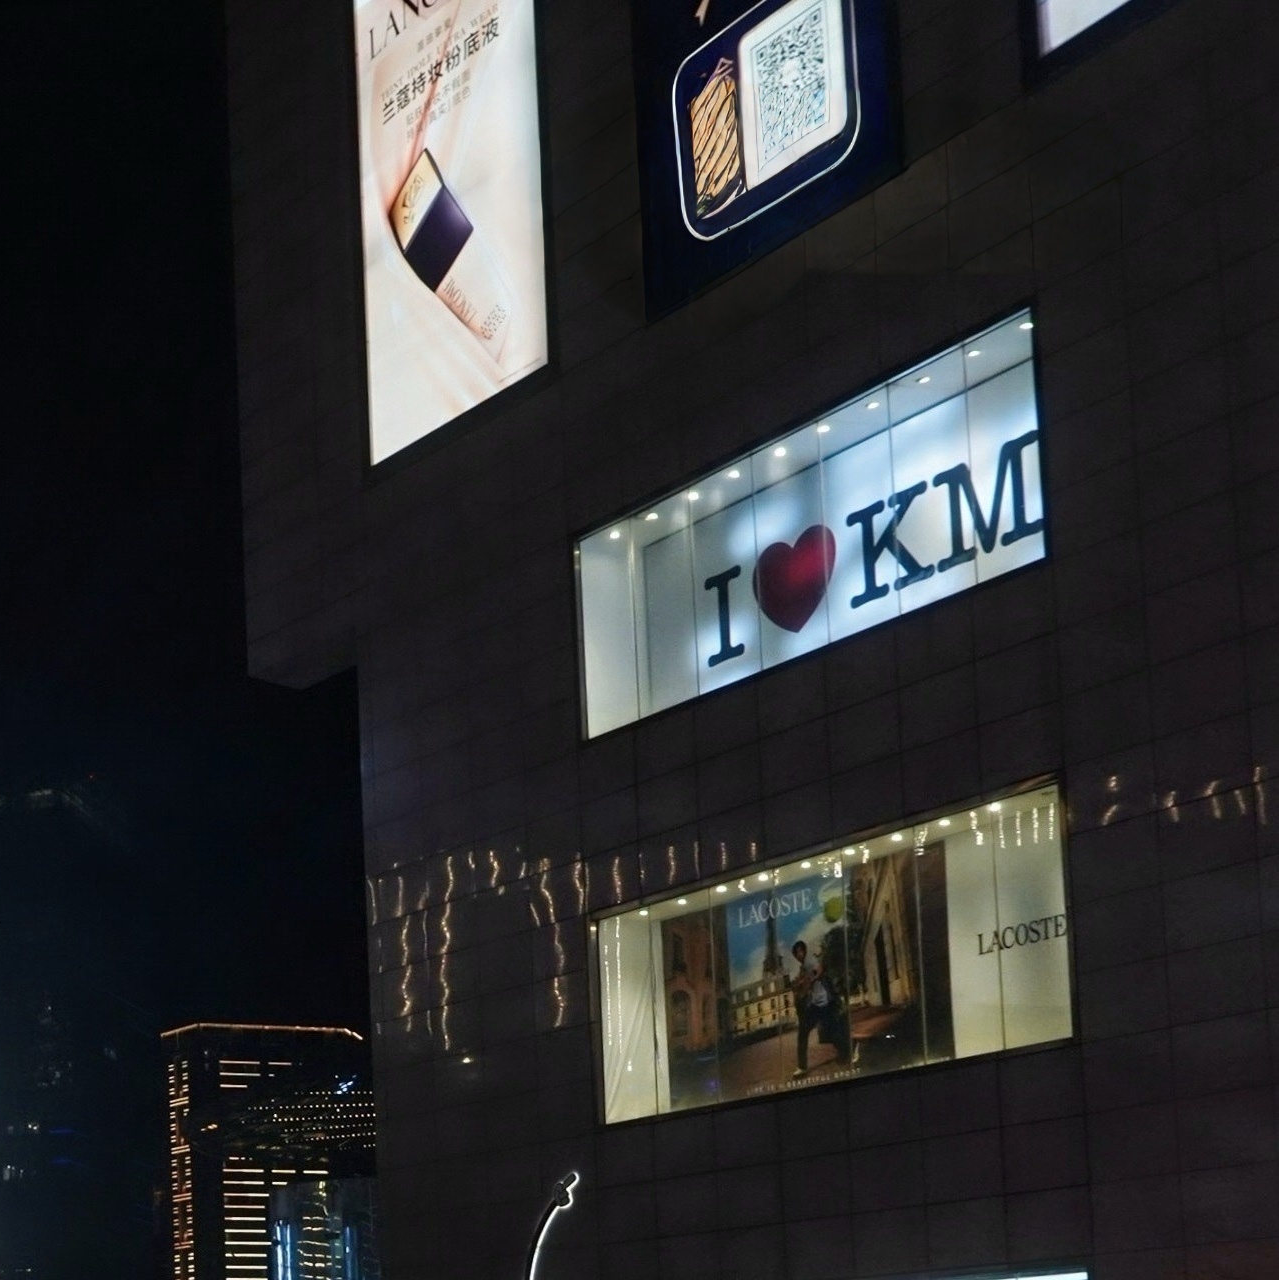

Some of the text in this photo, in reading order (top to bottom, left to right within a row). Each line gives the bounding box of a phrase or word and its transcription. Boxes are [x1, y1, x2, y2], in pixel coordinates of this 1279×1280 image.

[369, 0, 441, 61] LAN
[704, 430, 1044, 668] I KM
[738, 888, 813, 929] LACOSTE
[978, 914, 1068, 956] LACOSTE
